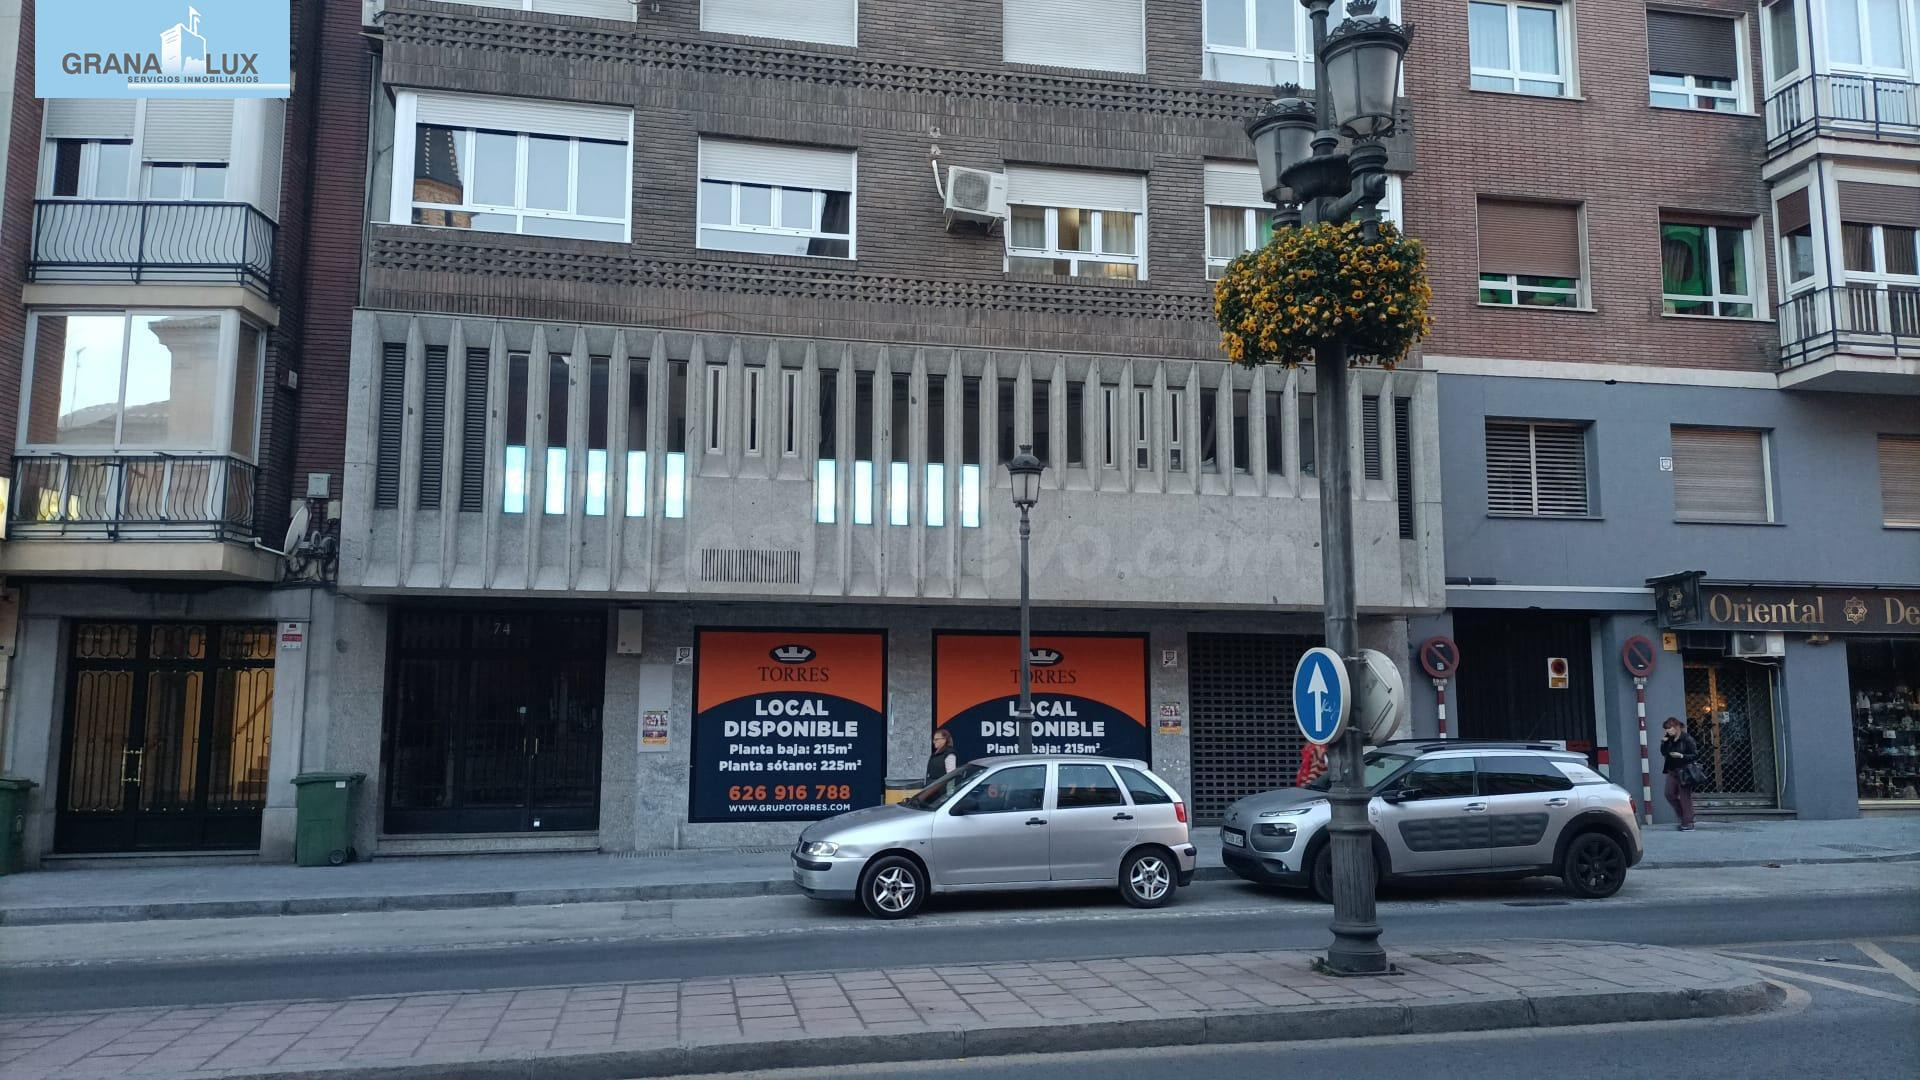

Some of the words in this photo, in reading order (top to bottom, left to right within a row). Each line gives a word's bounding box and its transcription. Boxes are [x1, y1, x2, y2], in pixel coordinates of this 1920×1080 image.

[1709, 593, 1825, 624] Oriental
[494, 622, 510, 636] 74
[758, 666, 829, 682] TORRES
[755, 699, 829, 716] LOCAL
[724, 720, 858, 737] DISPONIBLE
[730, 743, 773, 755] Planta
[777, 743, 810, 756] baja:
[813, 742, 853, 755] 215m²
[987, 743, 1019, 754] Plant
[1064, 743, 1101, 754] 215m²
[719, 760, 763, 772] Planta
[767, 760, 817, 771] sótano:
[820, 759, 862, 771] 225m²
[729, 785, 767, 801] 626
[774, 785, 808, 800] 916
[815, 784, 851, 800] 788
[728, 803, 851, 812] WWW.GRUPOTORRES.COM
